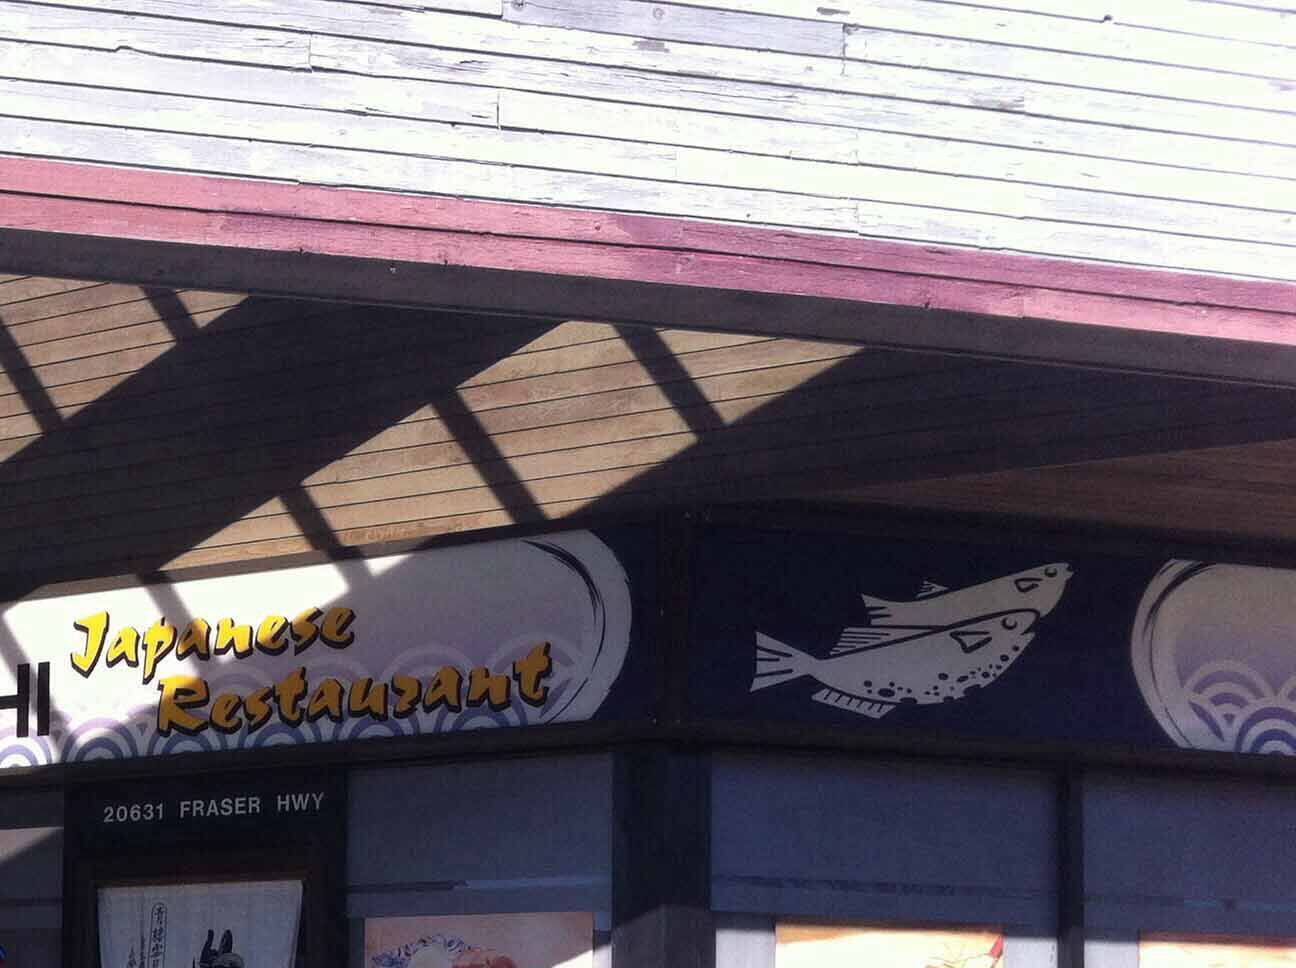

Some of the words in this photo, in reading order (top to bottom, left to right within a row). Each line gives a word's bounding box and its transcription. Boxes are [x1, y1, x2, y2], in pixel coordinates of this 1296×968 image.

[70, 608, 356, 684] Japanese
[156, 640, 553, 738] Restaurant
[103, 803, 164, 823] 20631
[179, 796, 261, 819] FRASER
[276, 792, 325, 812] HWY
